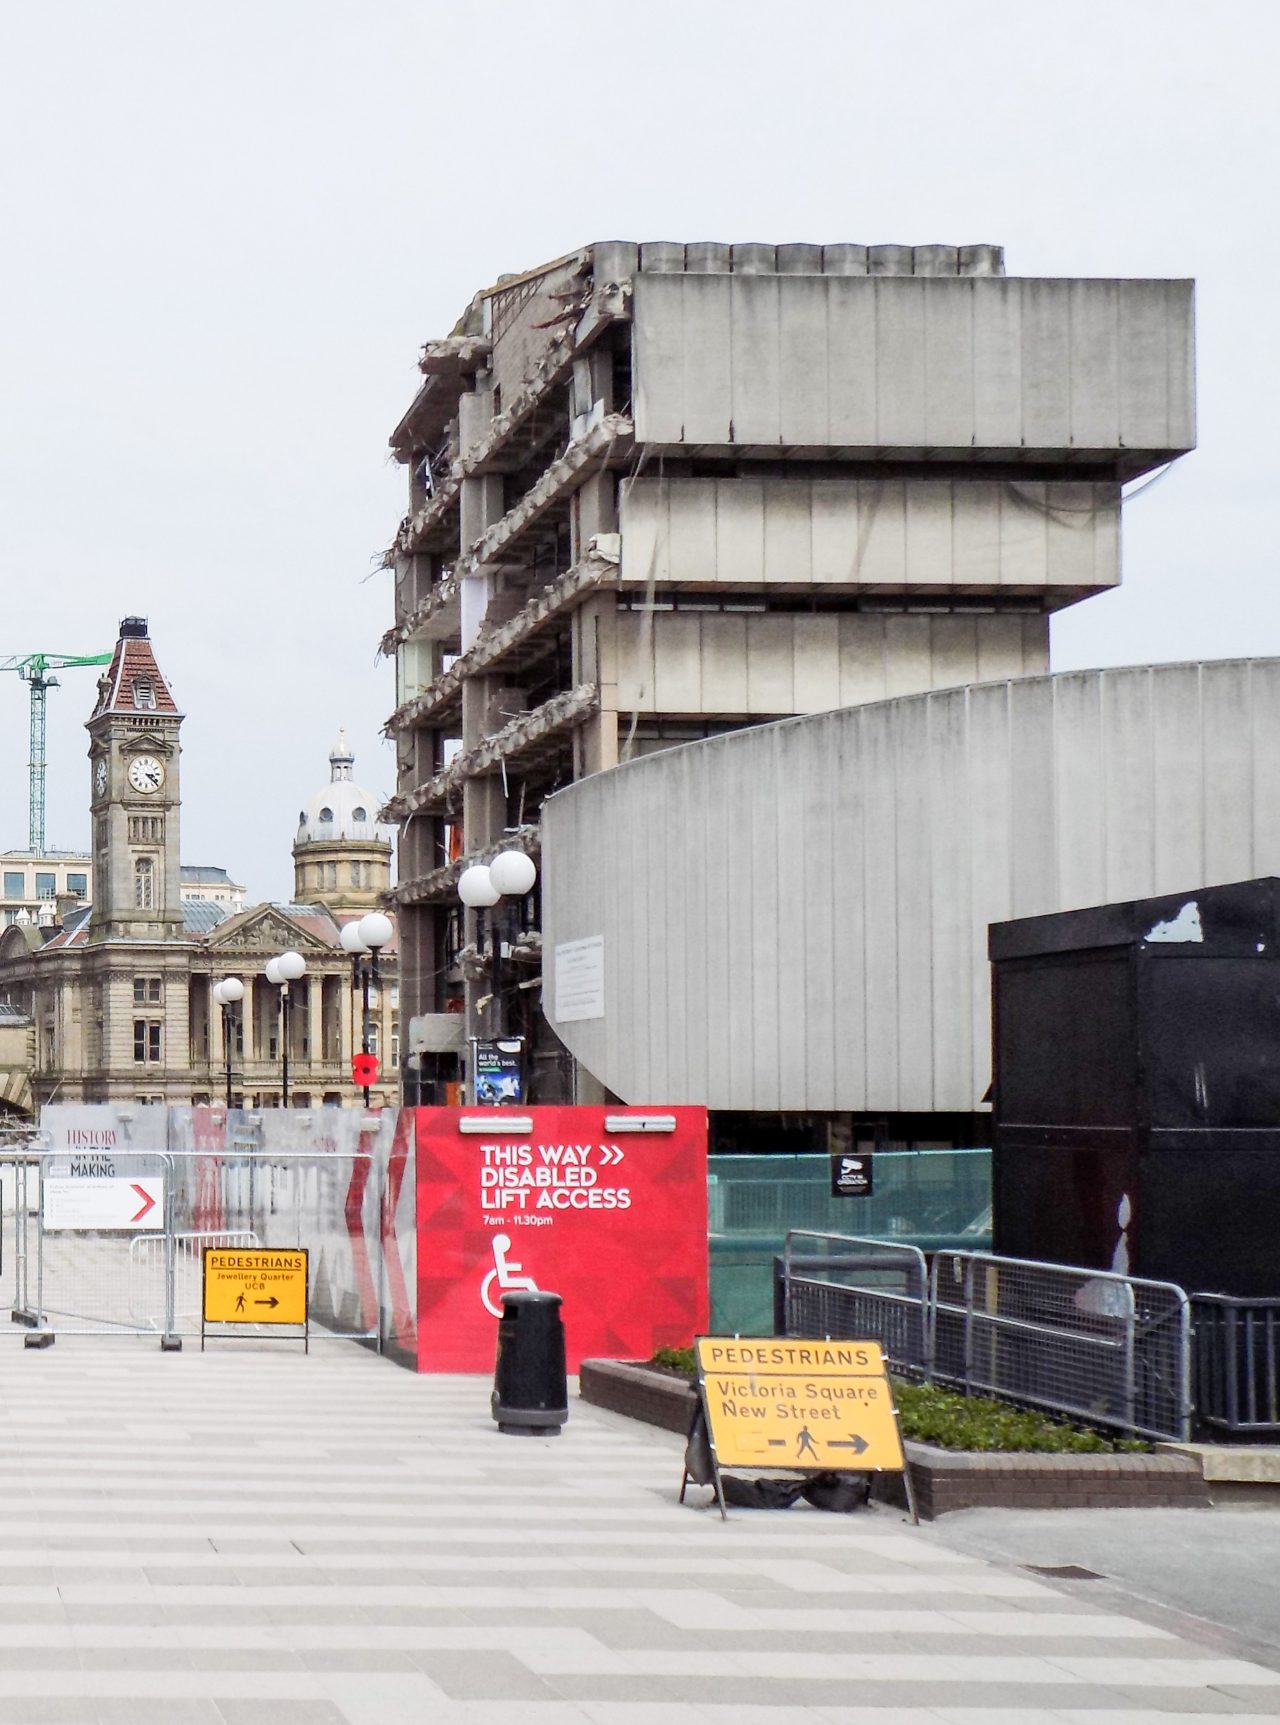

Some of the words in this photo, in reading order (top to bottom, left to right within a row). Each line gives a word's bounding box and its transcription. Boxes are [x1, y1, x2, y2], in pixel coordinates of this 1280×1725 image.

[478, 1053, 487, 1061] All
[488, 1053, 499, 1061] the
[67, 1129, 116, 1145] HISTORY
[480, 1145, 533, 1165] THIS
[538, 1145, 592, 1165] WAY
[70, 1163, 116, 1178] MAKING
[481, 1167, 597, 1187] DISABLED
[481, 1188, 530, 1209] LIFT
[536, 1188, 632, 1209] ACCESS
[483, 1215, 504, 1225] 7am
[514, 1215, 553, 1226] 11.30pm
[211, 1257, 302, 1268] PEDESTRIANS
[217, 1273, 257, 1281] Jewellery
[712, 1347, 869, 1366] PEDESTRIANS
[717, 1381, 797, 1399] Victoria
[805, 1383, 878, 1401] Square
[722, 1400, 767, 1418] New
[776, 1403, 842, 1420] Street
